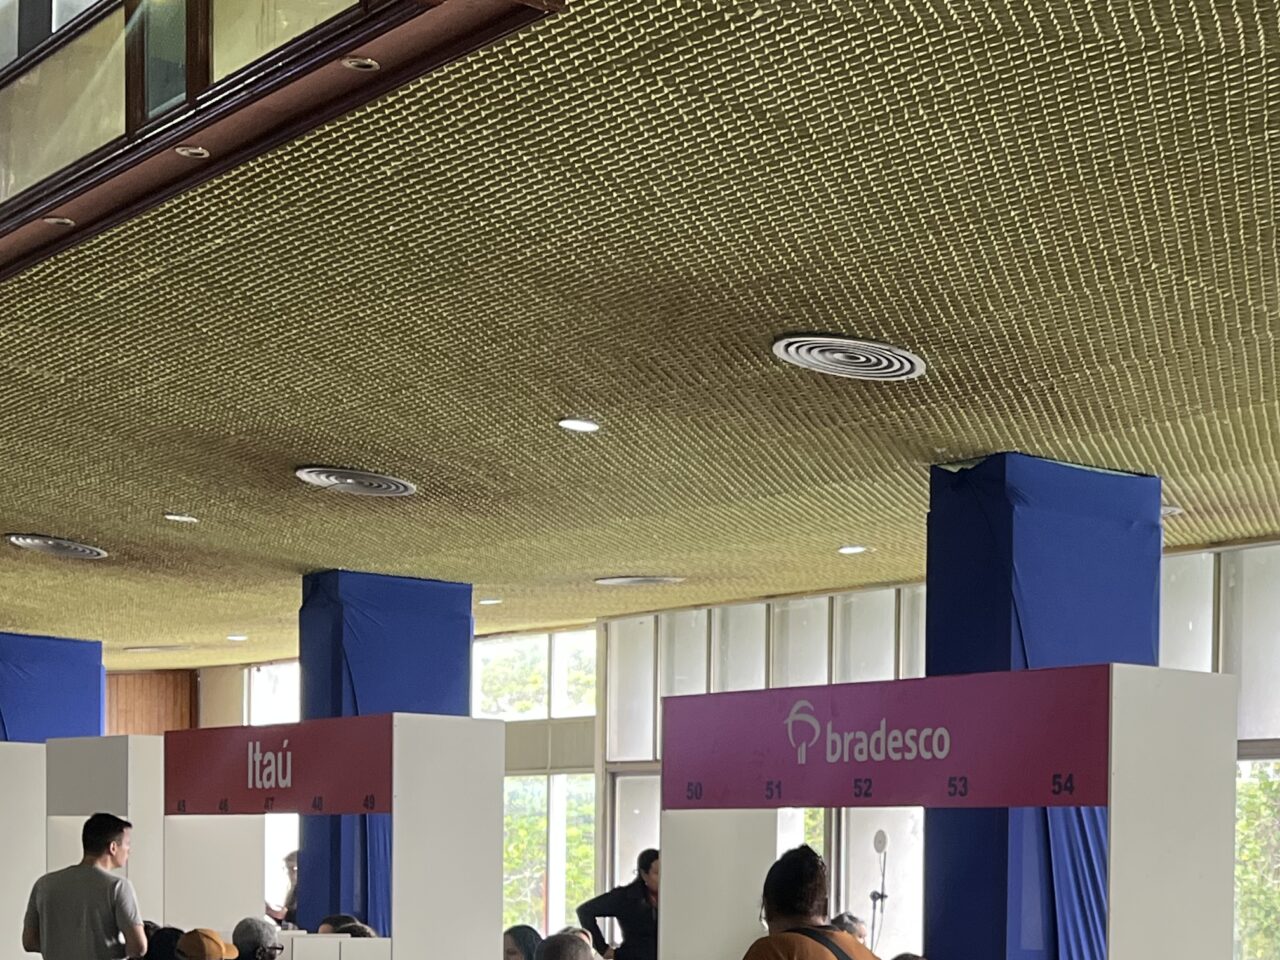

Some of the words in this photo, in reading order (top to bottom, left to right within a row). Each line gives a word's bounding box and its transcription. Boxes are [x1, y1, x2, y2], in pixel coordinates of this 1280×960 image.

[825, 717, 951, 763] bradesco
[247, 739, 292, 789] Itaú
[363, 794, 375, 810] 49
[686, 781, 703, 800] 50
[765, 780, 782, 800] 51
[853, 778, 873, 798] 52
[947, 776, 968, 796] 53
[1051, 773, 1075, 795] 54
